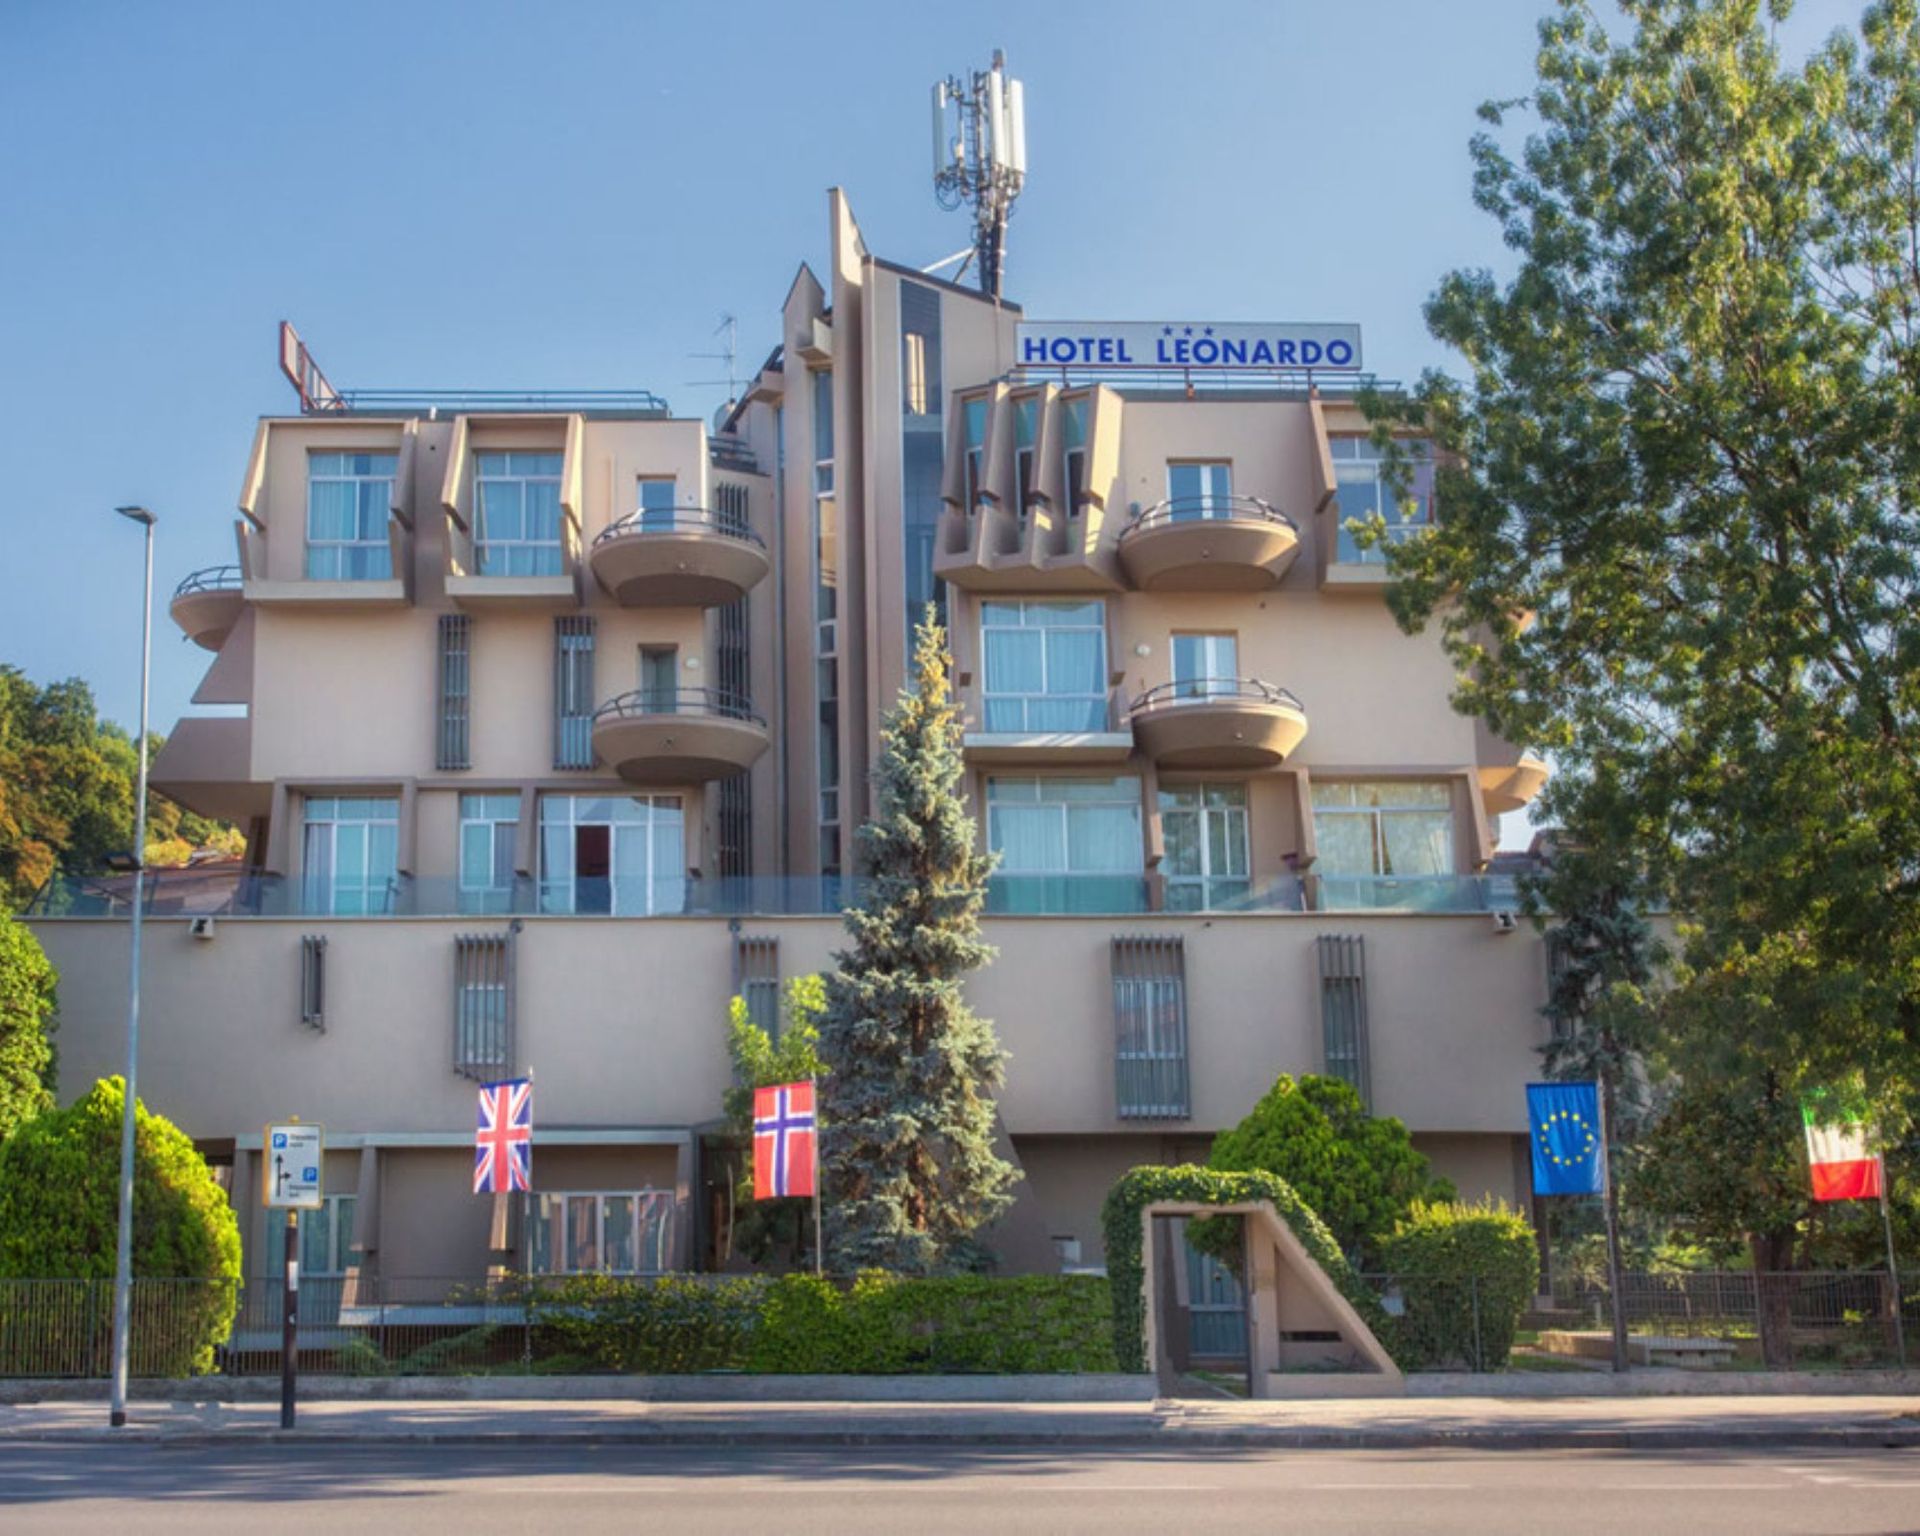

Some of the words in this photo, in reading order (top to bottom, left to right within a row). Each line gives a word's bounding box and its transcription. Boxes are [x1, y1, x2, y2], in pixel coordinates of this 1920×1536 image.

[1024, 337, 1132, 363] HOTEL
[1157, 338, 1353, 365] LEONARDO
[274, 1134, 285, 1147] P
